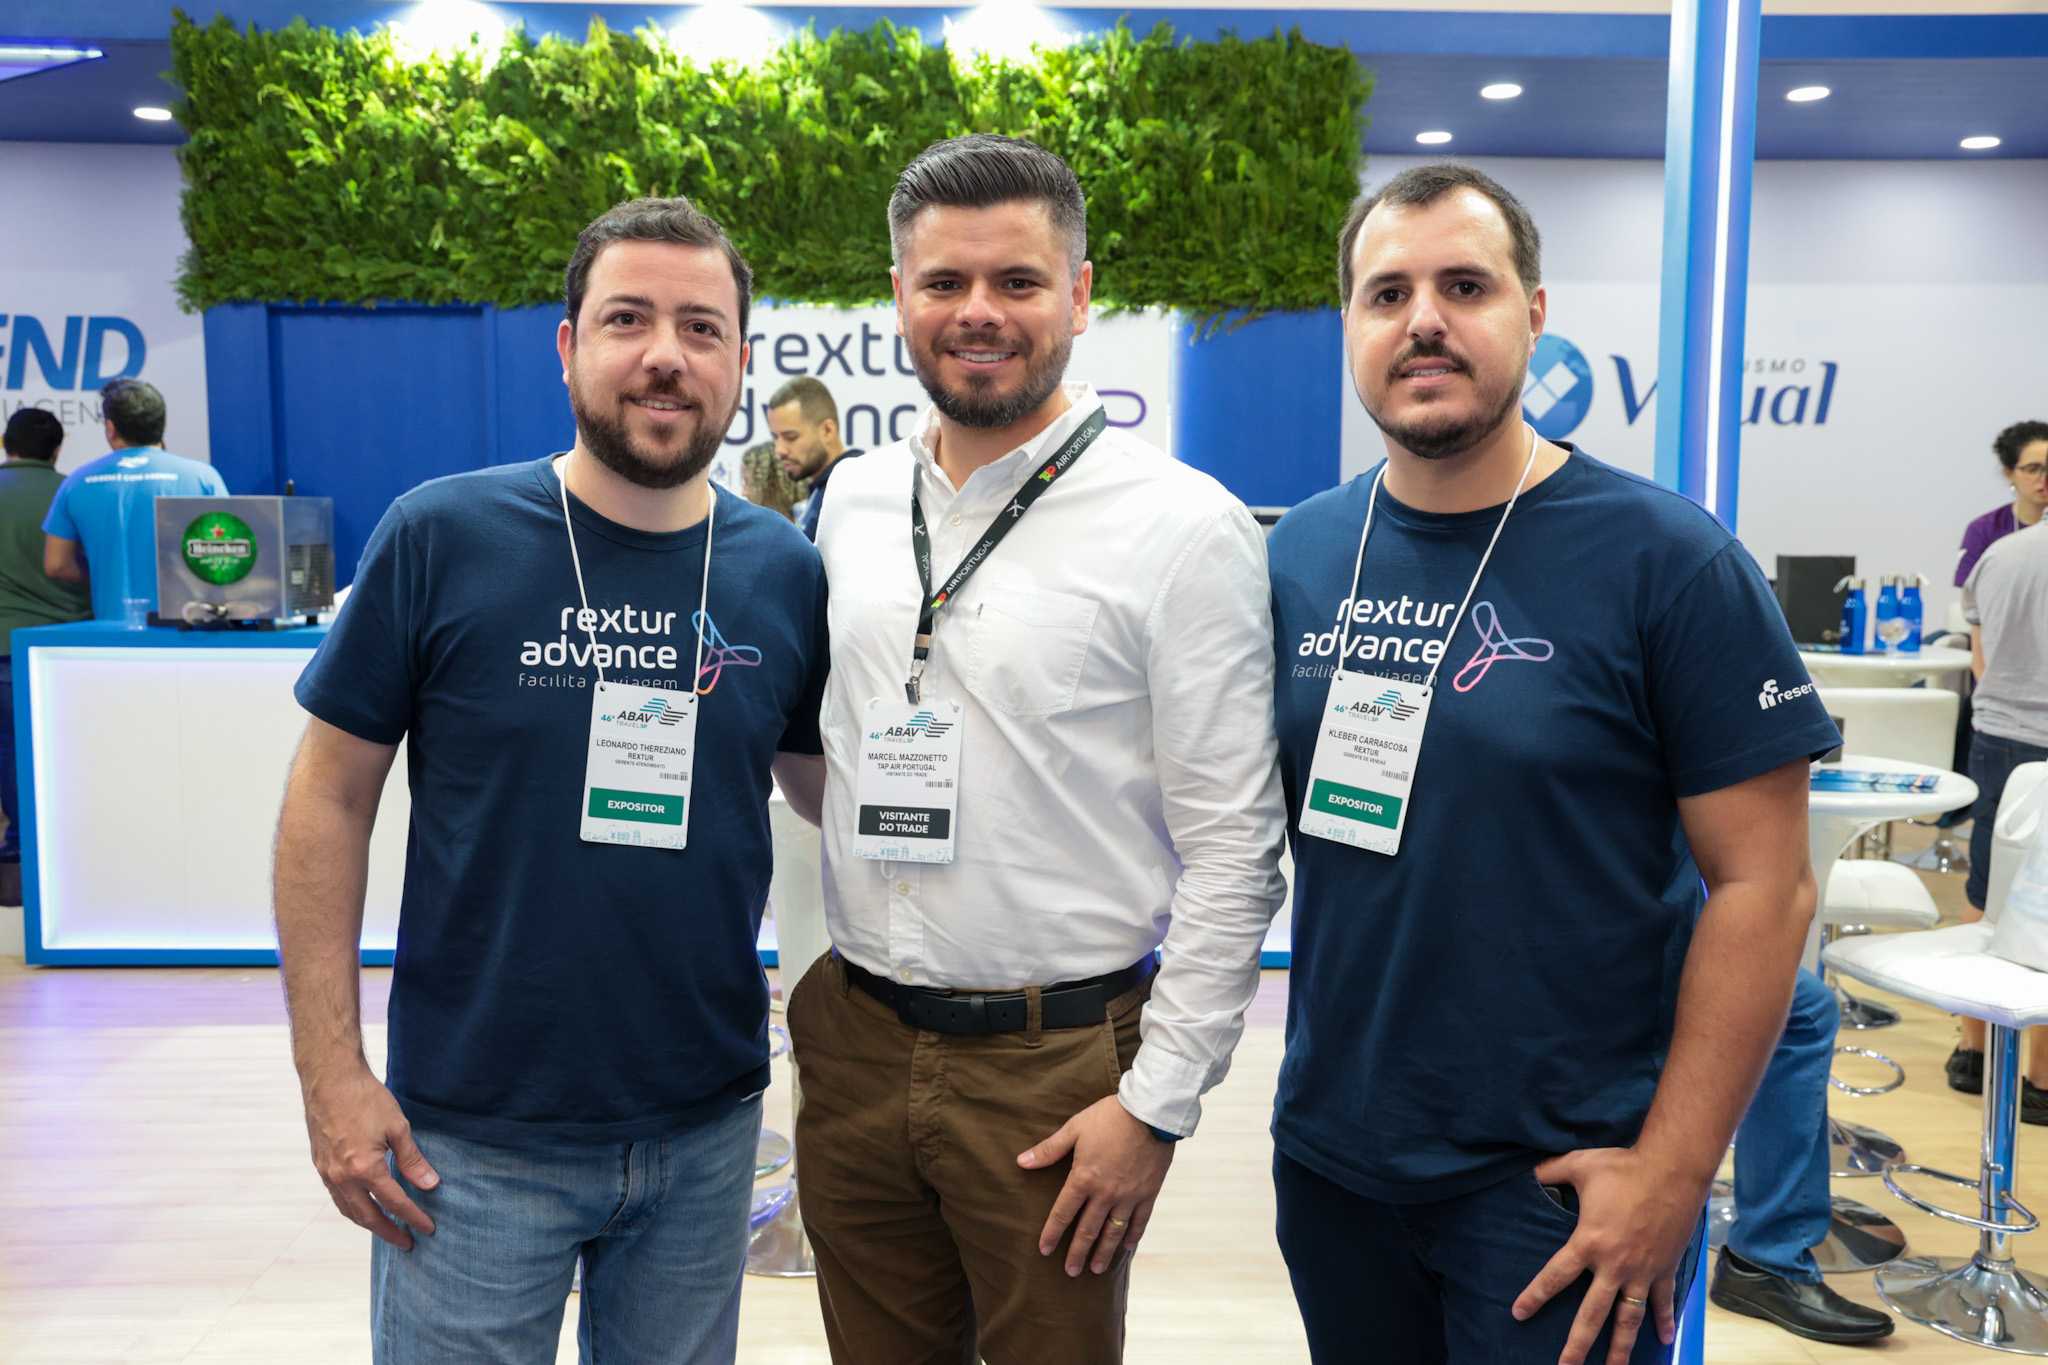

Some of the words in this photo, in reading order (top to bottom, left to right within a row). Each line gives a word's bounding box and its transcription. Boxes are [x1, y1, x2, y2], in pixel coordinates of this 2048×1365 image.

[0, 314, 146, 391] ND
[1336, 595, 1455, 628] rextur
[561, 604, 676, 635] rextur
[520, 634, 678, 669] advance
[1298, 625, 1446, 664] advance
[1292, 664, 1334, 679] facilit
[518, 673, 586, 688] facilita
[1350, 701, 1386, 716] ABAV
[617, 710, 653, 723] ABAV
[885, 726, 919, 737] ABAV
[596, 739, 638, 750] LEONARDO
[640, 743, 686, 755] THEREZIANO
[1328, 729, 1357, 742] KLEBER
[1359, 736, 1408, 753] CARRASCOSA
[628, 752, 654, 761] REXTUR
[868, 753, 897, 761] MARCEL
[899, 754, 947, 762] MAZZONETTO
[1354, 745, 1379, 756] REXTUR
[1343, 752, 1362, 760] GERENTE
[1369, 757, 1386, 766] VENDAS
[607, 800, 665, 813] EXPOSITOR
[1328, 793, 1383, 815] EXPOSITOR
[879, 811, 930, 822] VISITANTE
[879, 823, 894, 831] DO
[896, 823, 928, 833] TRADE
